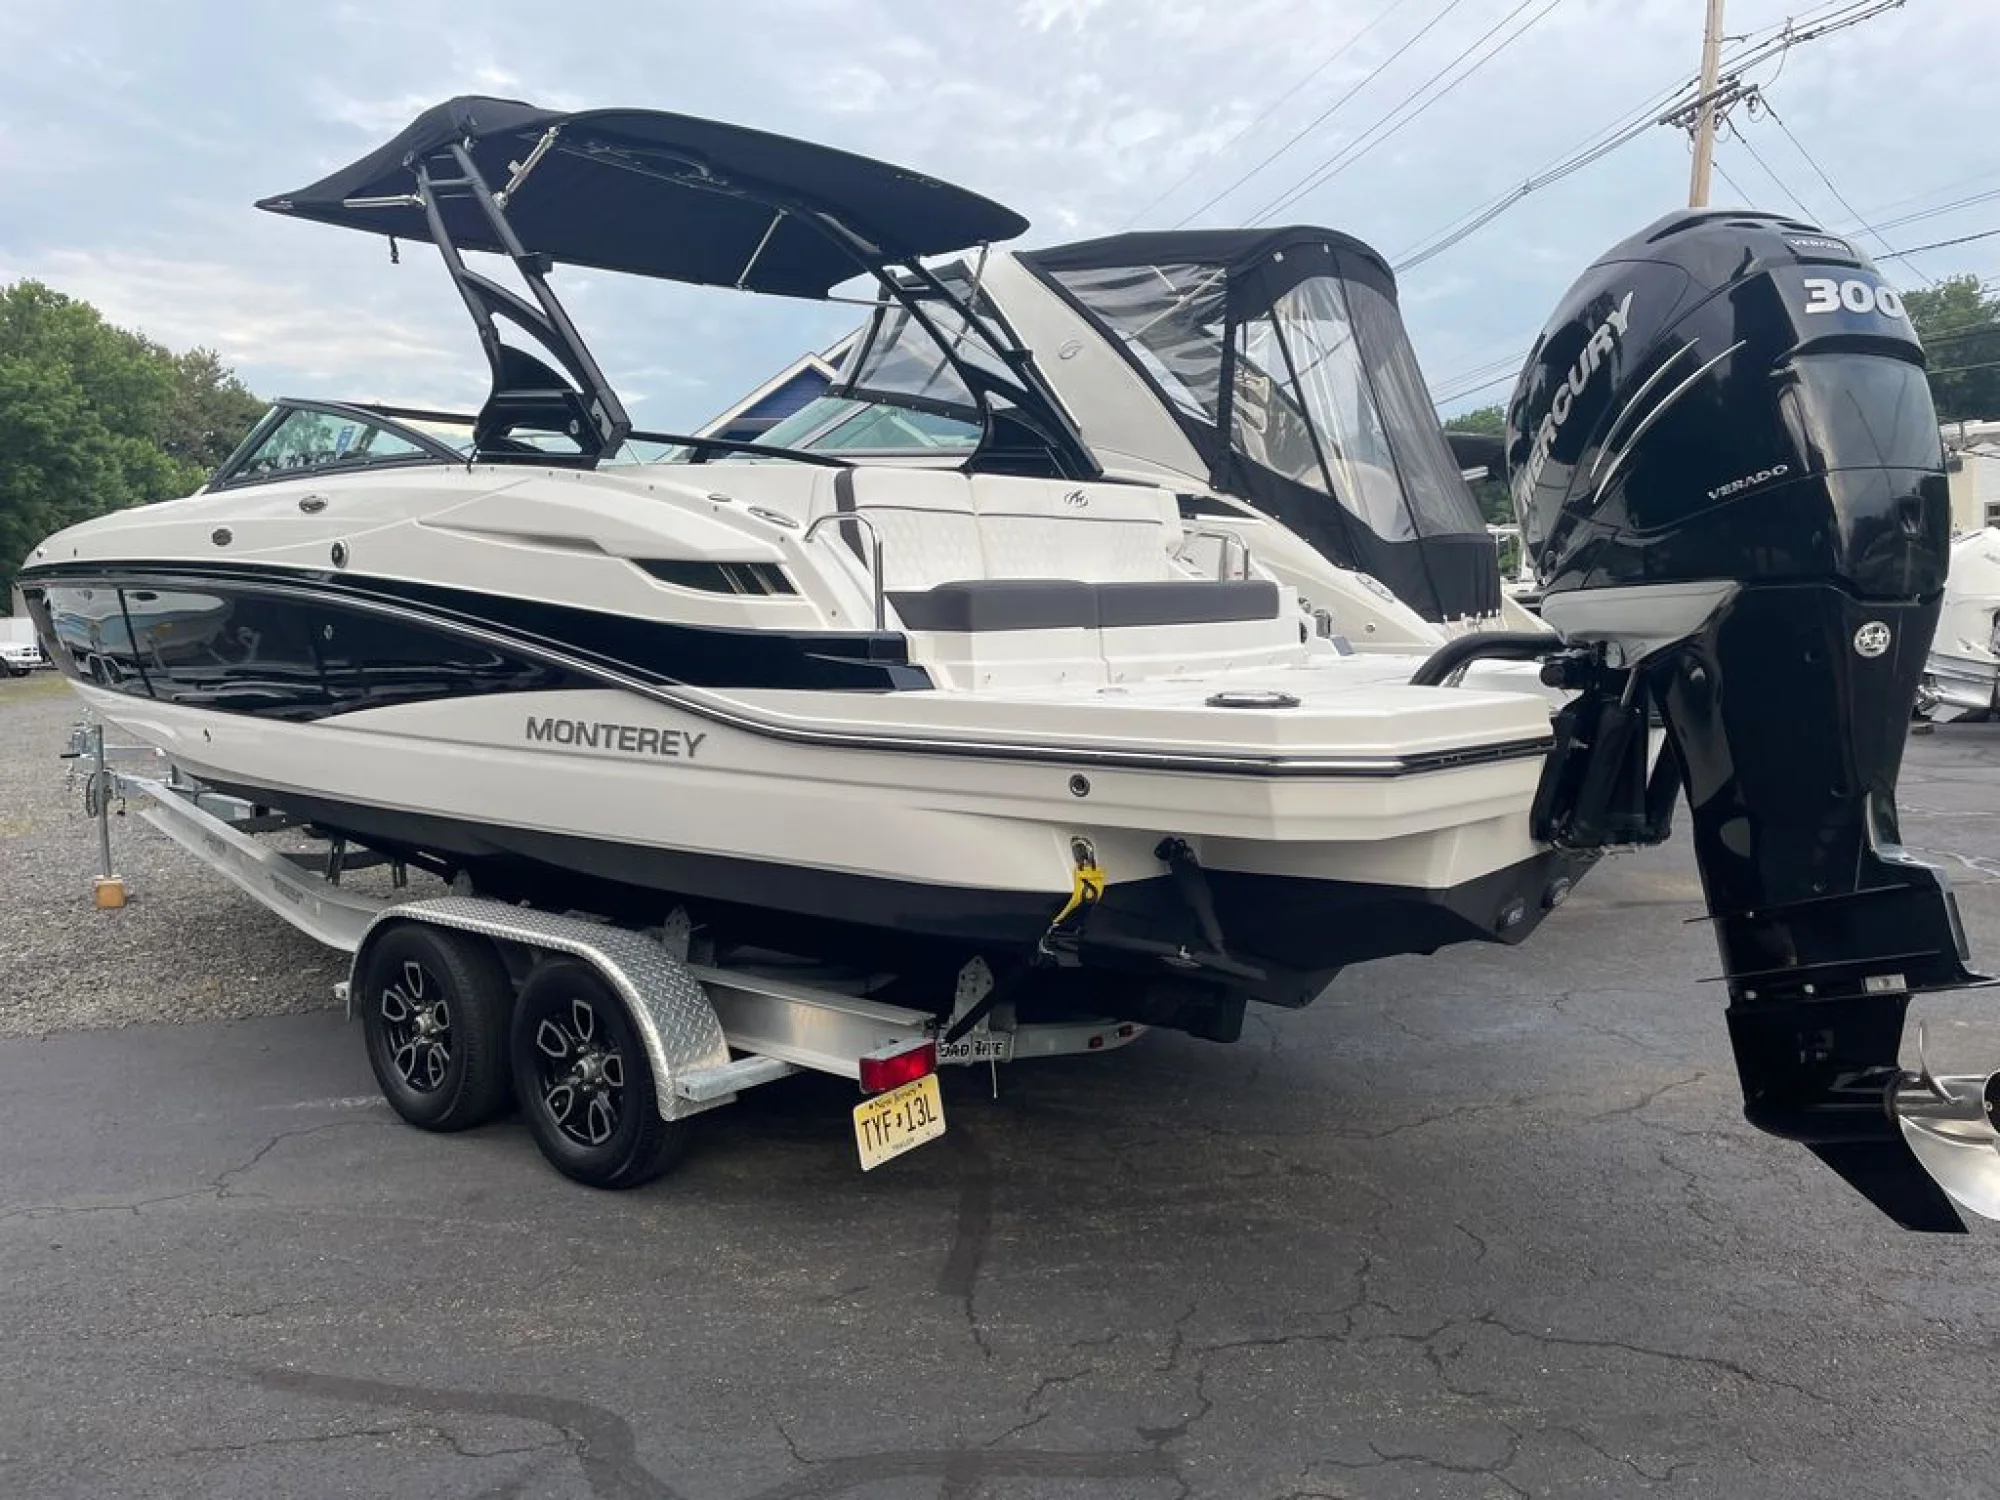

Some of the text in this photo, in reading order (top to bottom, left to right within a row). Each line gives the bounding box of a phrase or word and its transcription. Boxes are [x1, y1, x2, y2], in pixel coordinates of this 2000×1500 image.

[1803, 278, 1905, 318] 300
[1512, 291, 1634, 518] MERCURY
[1707, 464, 1788, 500] VERADO
[526, 716, 707, 758] MONTEREY
